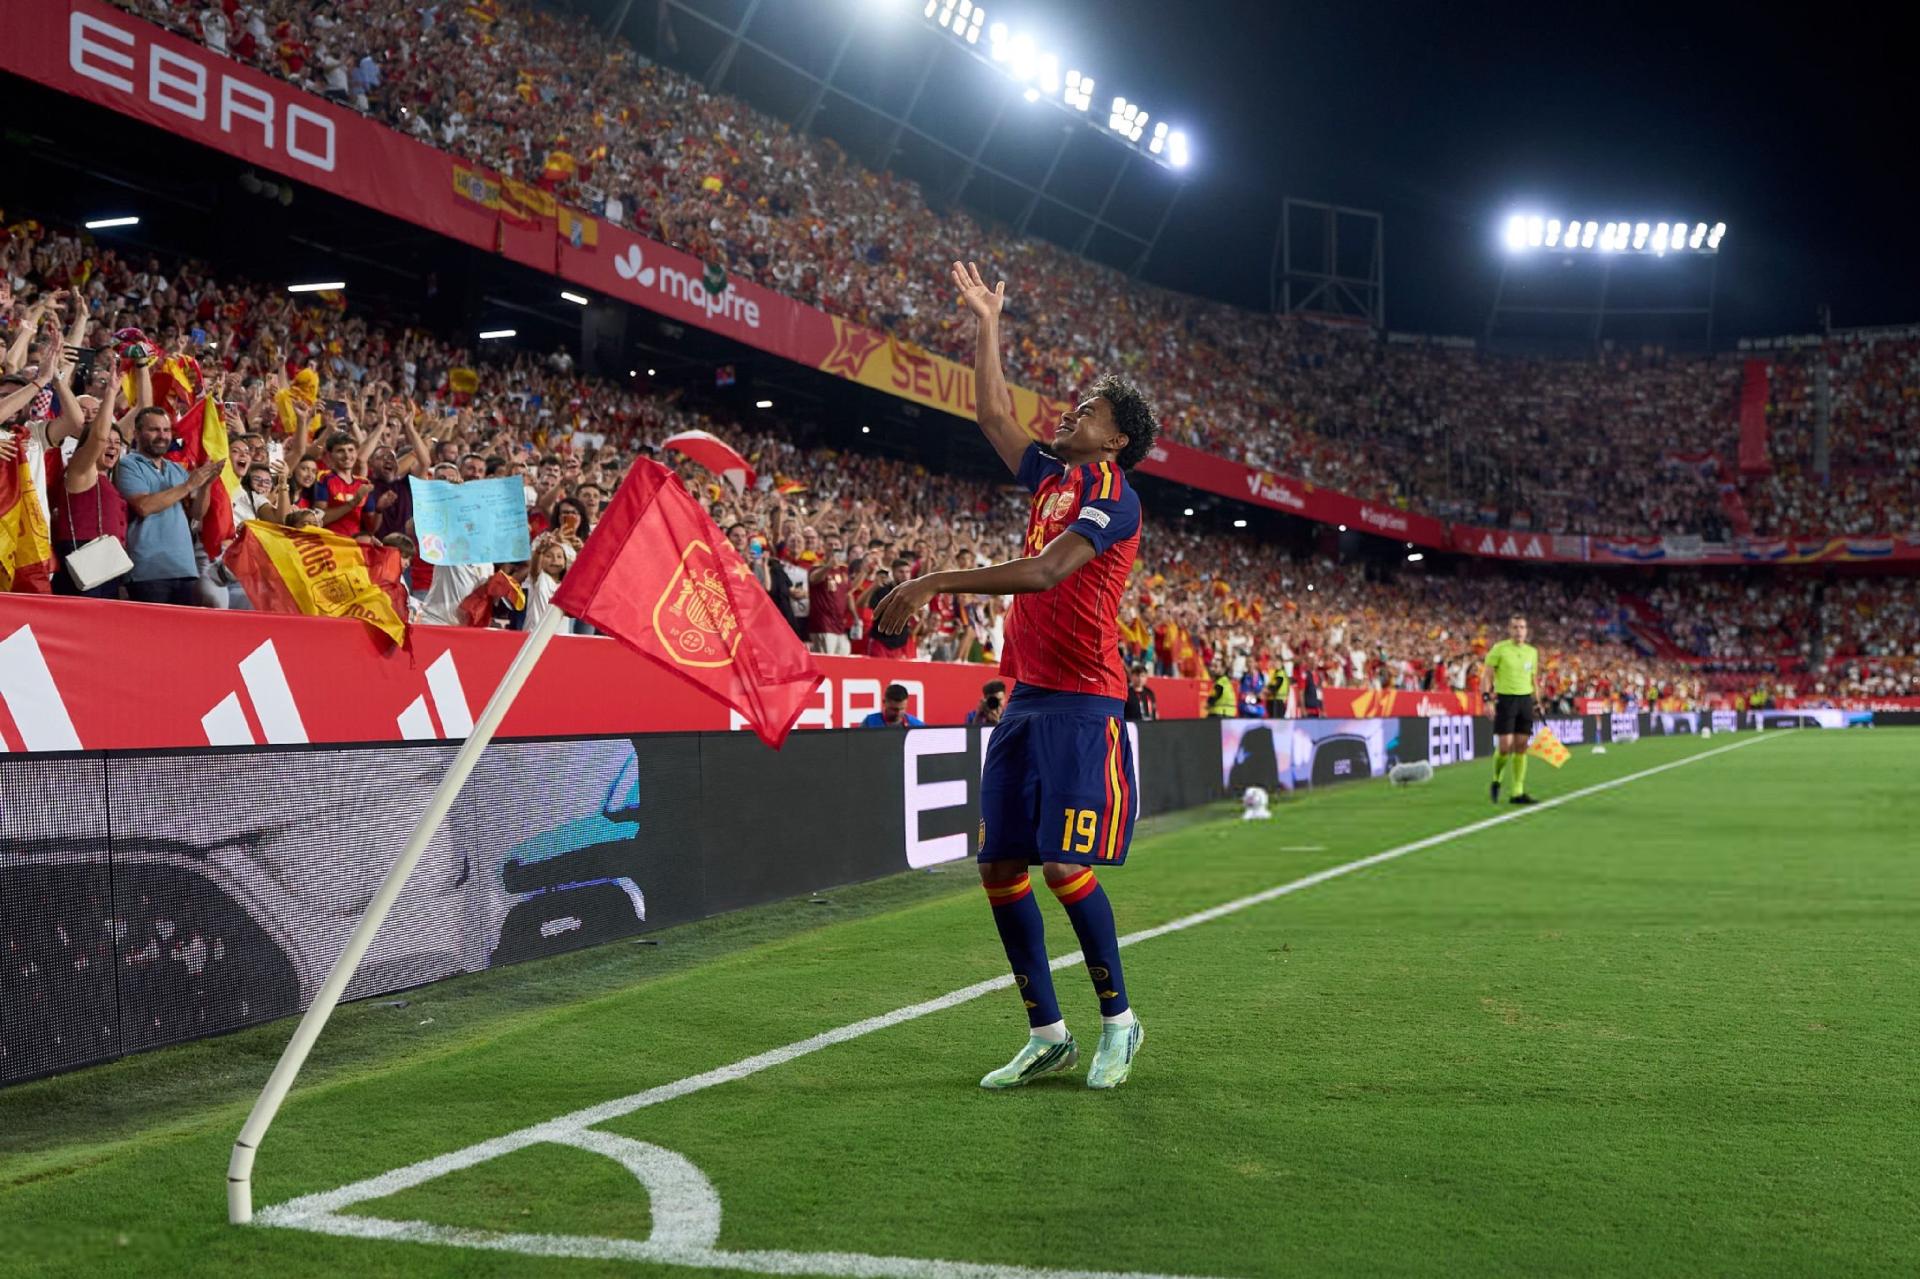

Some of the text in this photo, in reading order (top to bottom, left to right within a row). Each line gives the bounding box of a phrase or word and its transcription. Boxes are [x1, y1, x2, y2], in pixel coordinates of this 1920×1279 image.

[69, 11, 335, 172] EBRO
[660, 266, 760, 328] mapfre
[730, 678, 925, 731] BRO
[1062, 808, 1098, 854] 19
